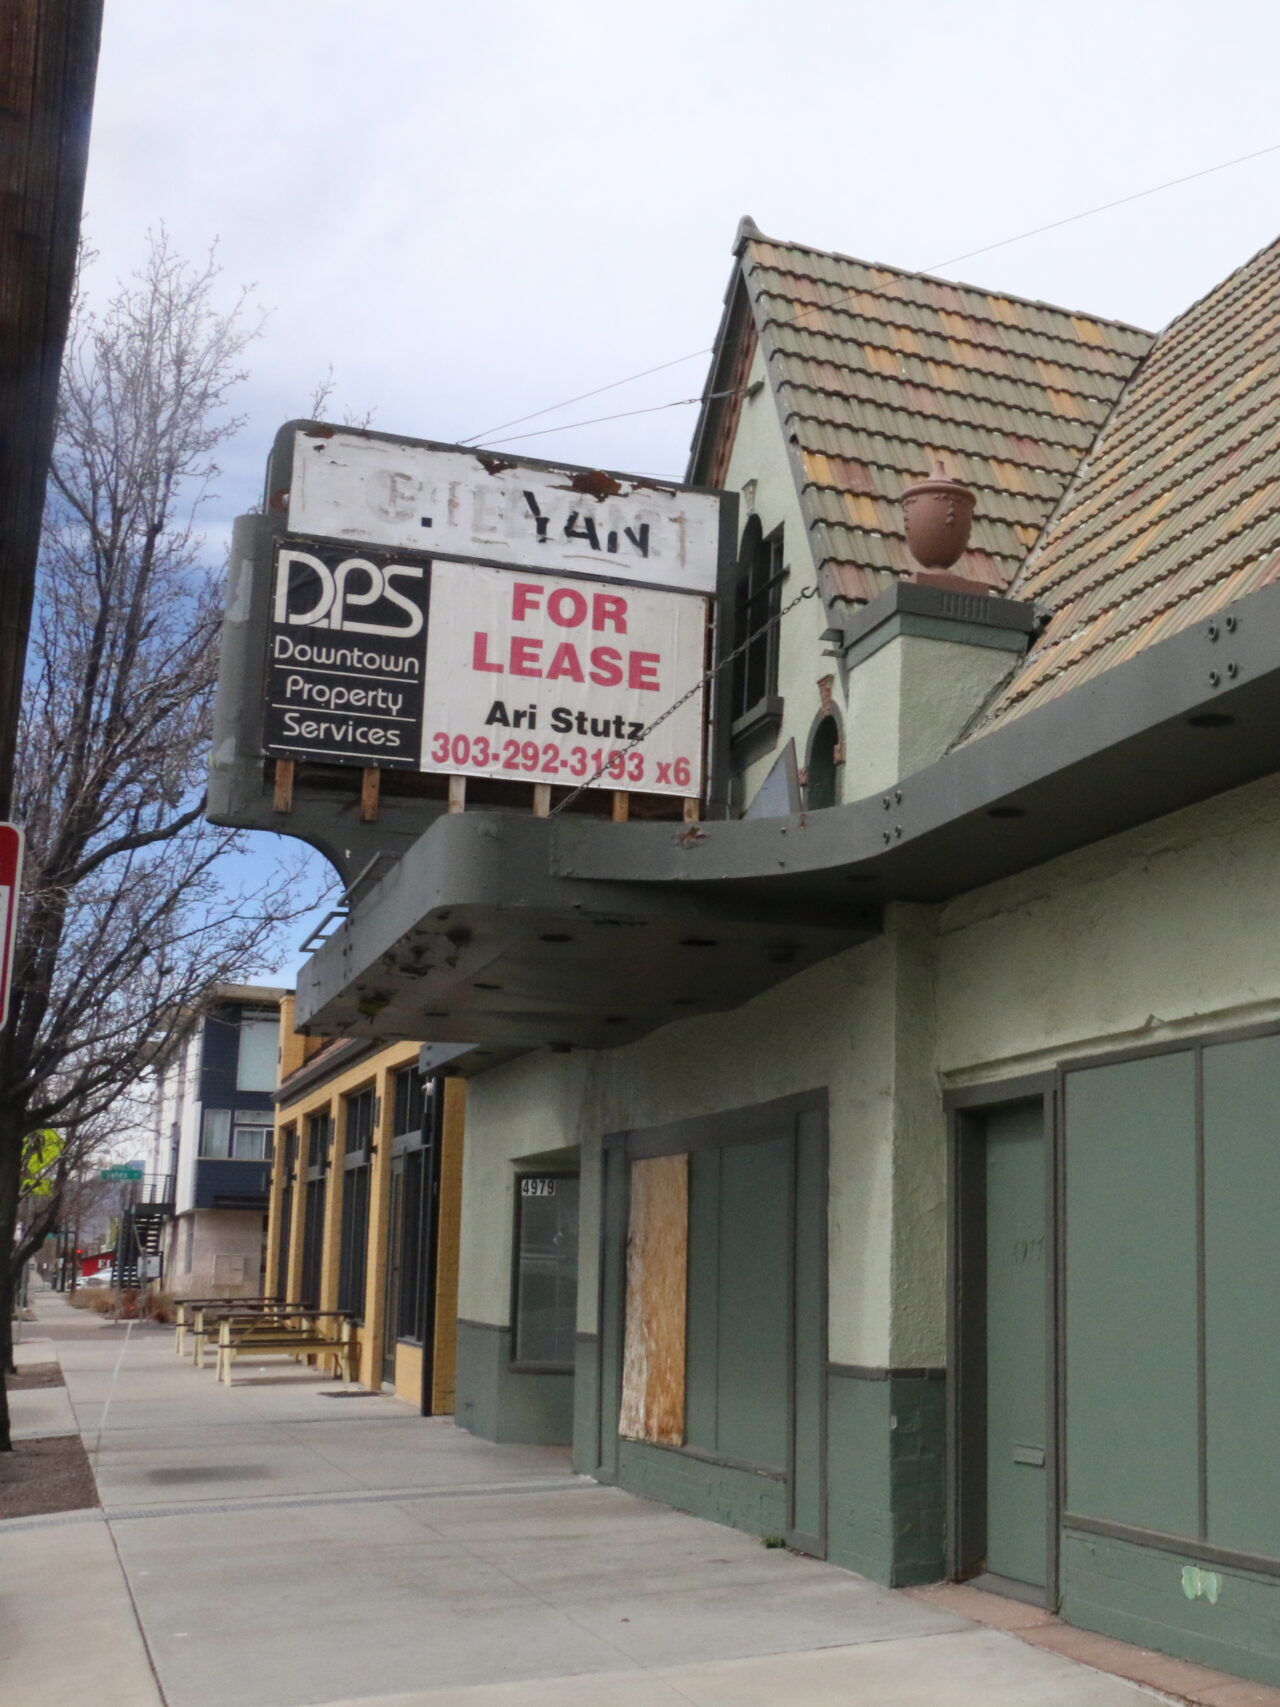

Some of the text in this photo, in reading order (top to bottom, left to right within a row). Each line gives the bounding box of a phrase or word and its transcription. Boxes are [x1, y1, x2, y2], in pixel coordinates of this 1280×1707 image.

[273, 549, 423, 639] DPS
[511, 582, 628, 635] FOR
[274, 635, 419, 675] Downtown
[472, 632, 660, 692] LEASE
[286, 674, 403, 717] Property
[282, 712, 401, 748] Services
[485, 700, 646, 742] Ari Stutz
[655, 756, 691, 787] x6
[522, 1180, 555, 1195] 4979
